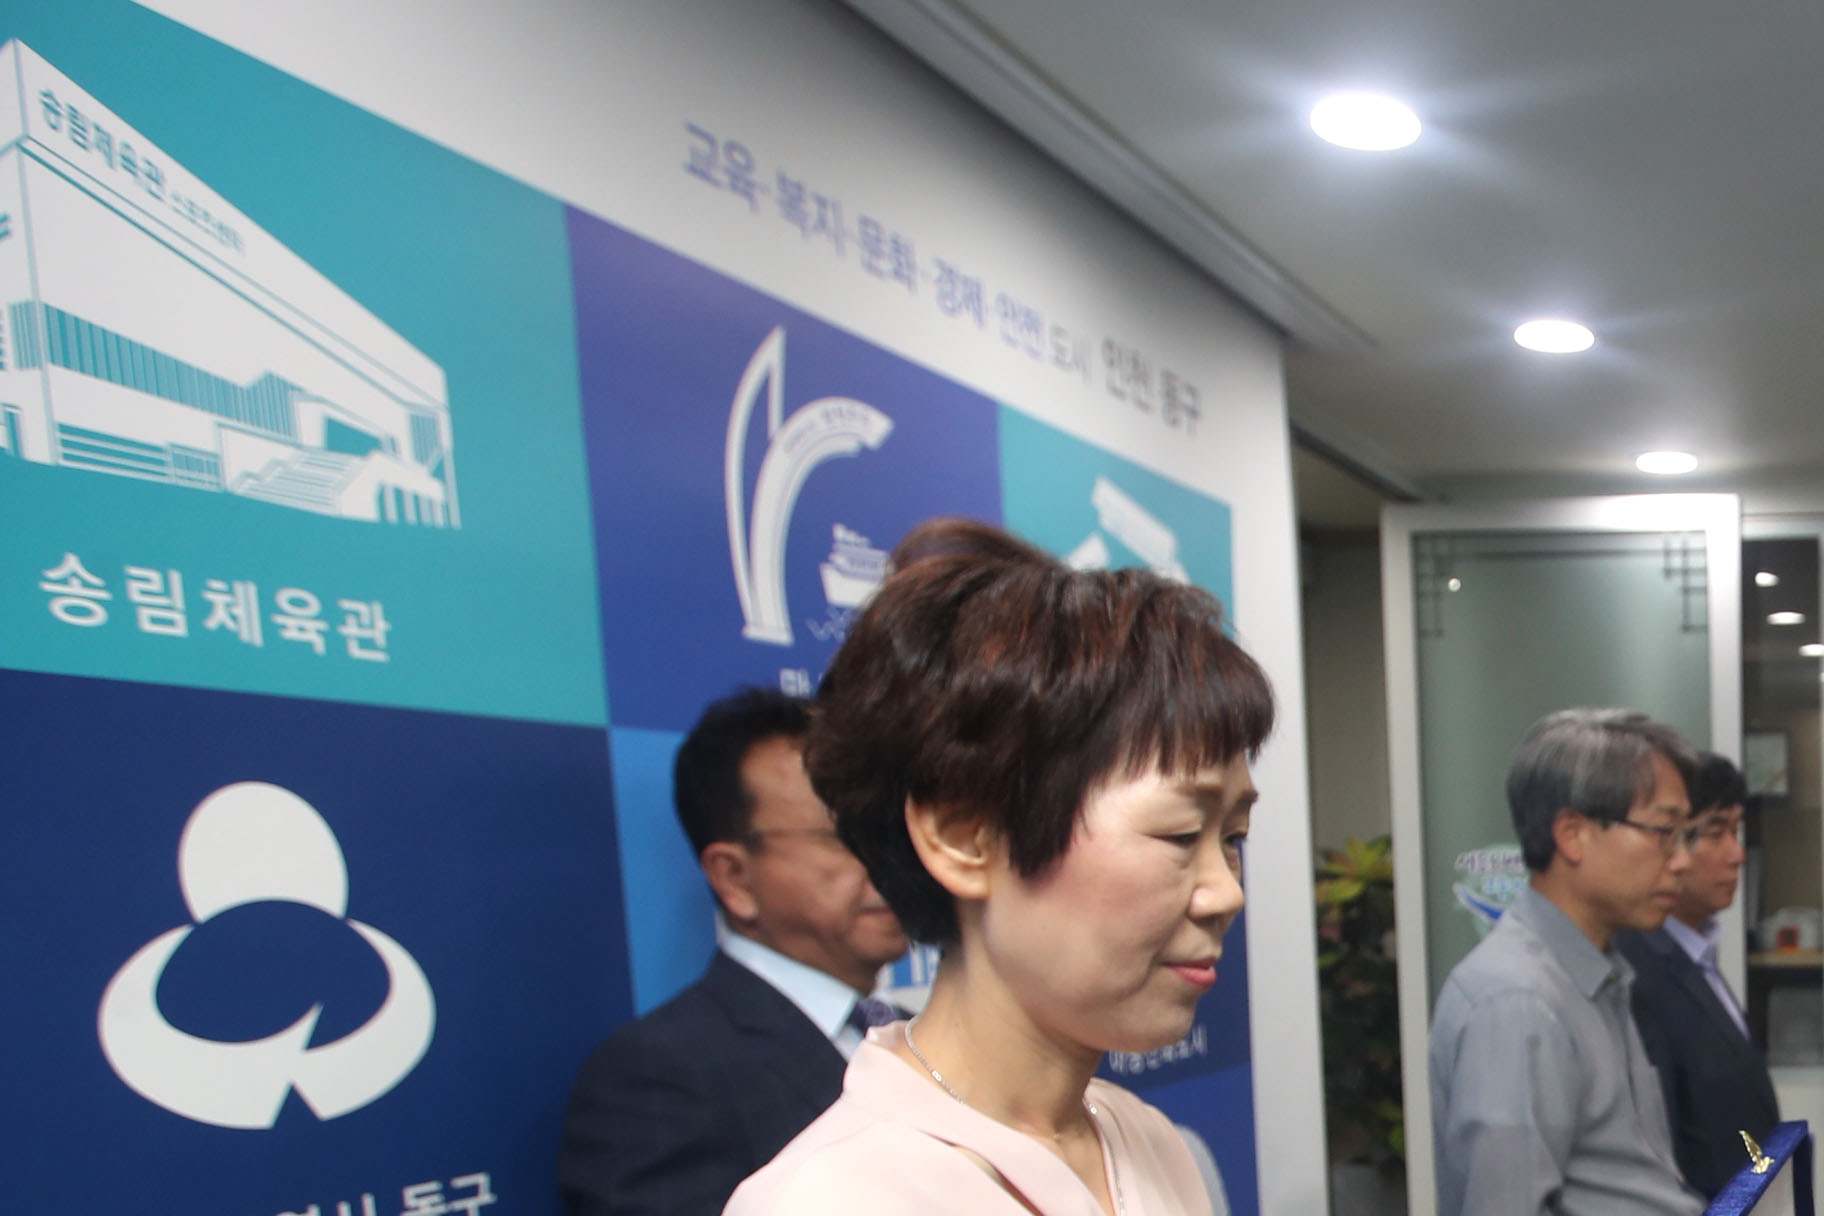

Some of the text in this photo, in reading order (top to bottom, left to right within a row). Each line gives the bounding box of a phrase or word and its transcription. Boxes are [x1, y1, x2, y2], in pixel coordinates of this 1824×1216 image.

[683, 120, 759, 215] 교육
[1101, 334, 1154, 416] 인천
[1160, 367, 1203, 438] 동구
[39, 552, 391, 662] 송림체육관
